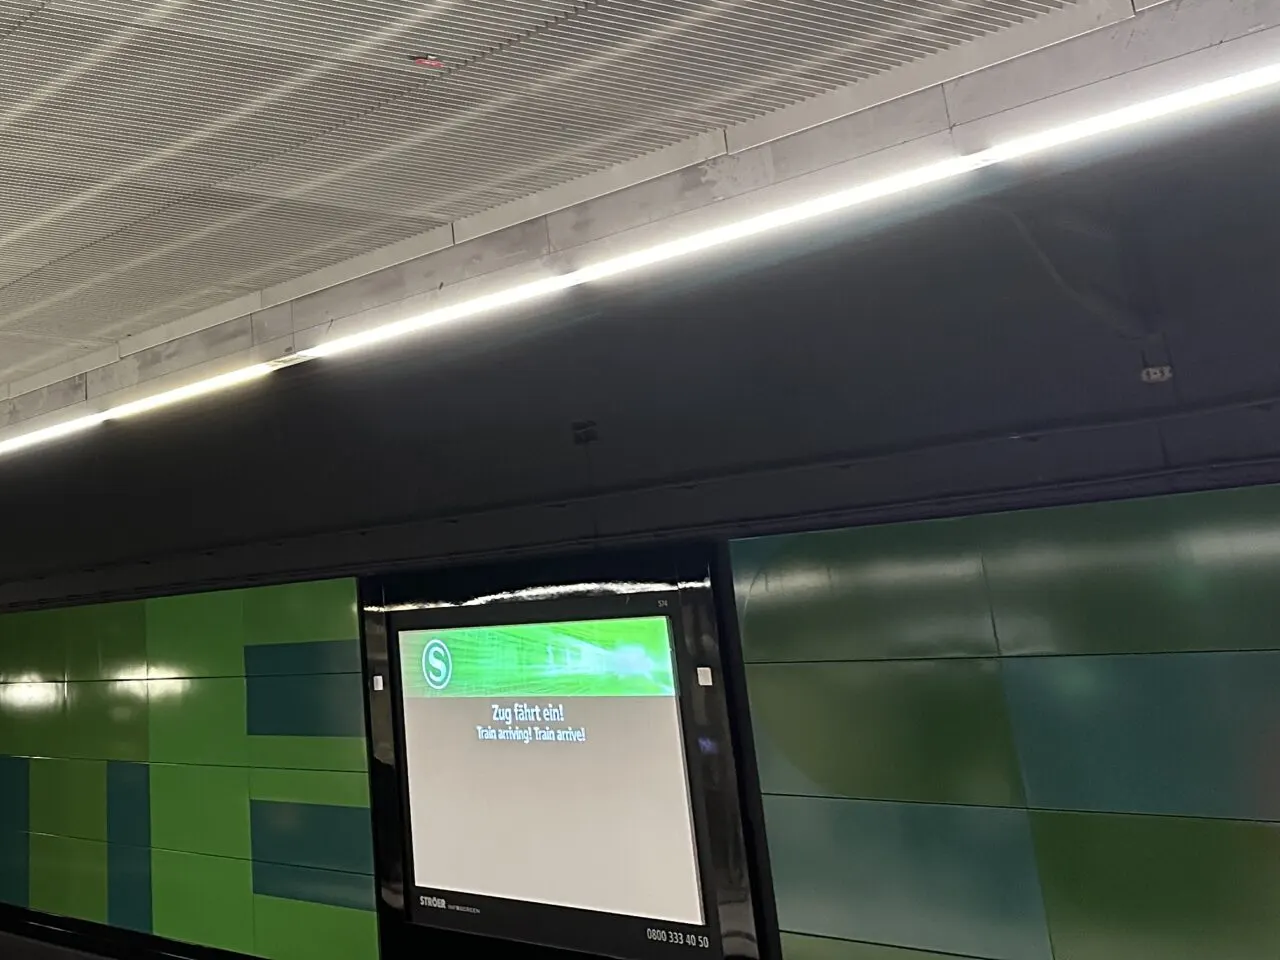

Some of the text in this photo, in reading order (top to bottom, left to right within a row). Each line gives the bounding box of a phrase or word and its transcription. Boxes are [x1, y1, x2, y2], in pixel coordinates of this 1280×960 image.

[491, 703, 565, 725] Zug fährt ein!
[476, 726, 586, 744] Train arriving! Train arrive!
[420, 895, 446, 909] STRÖER
[646, 928, 709, 948] 0800 333 40 50
